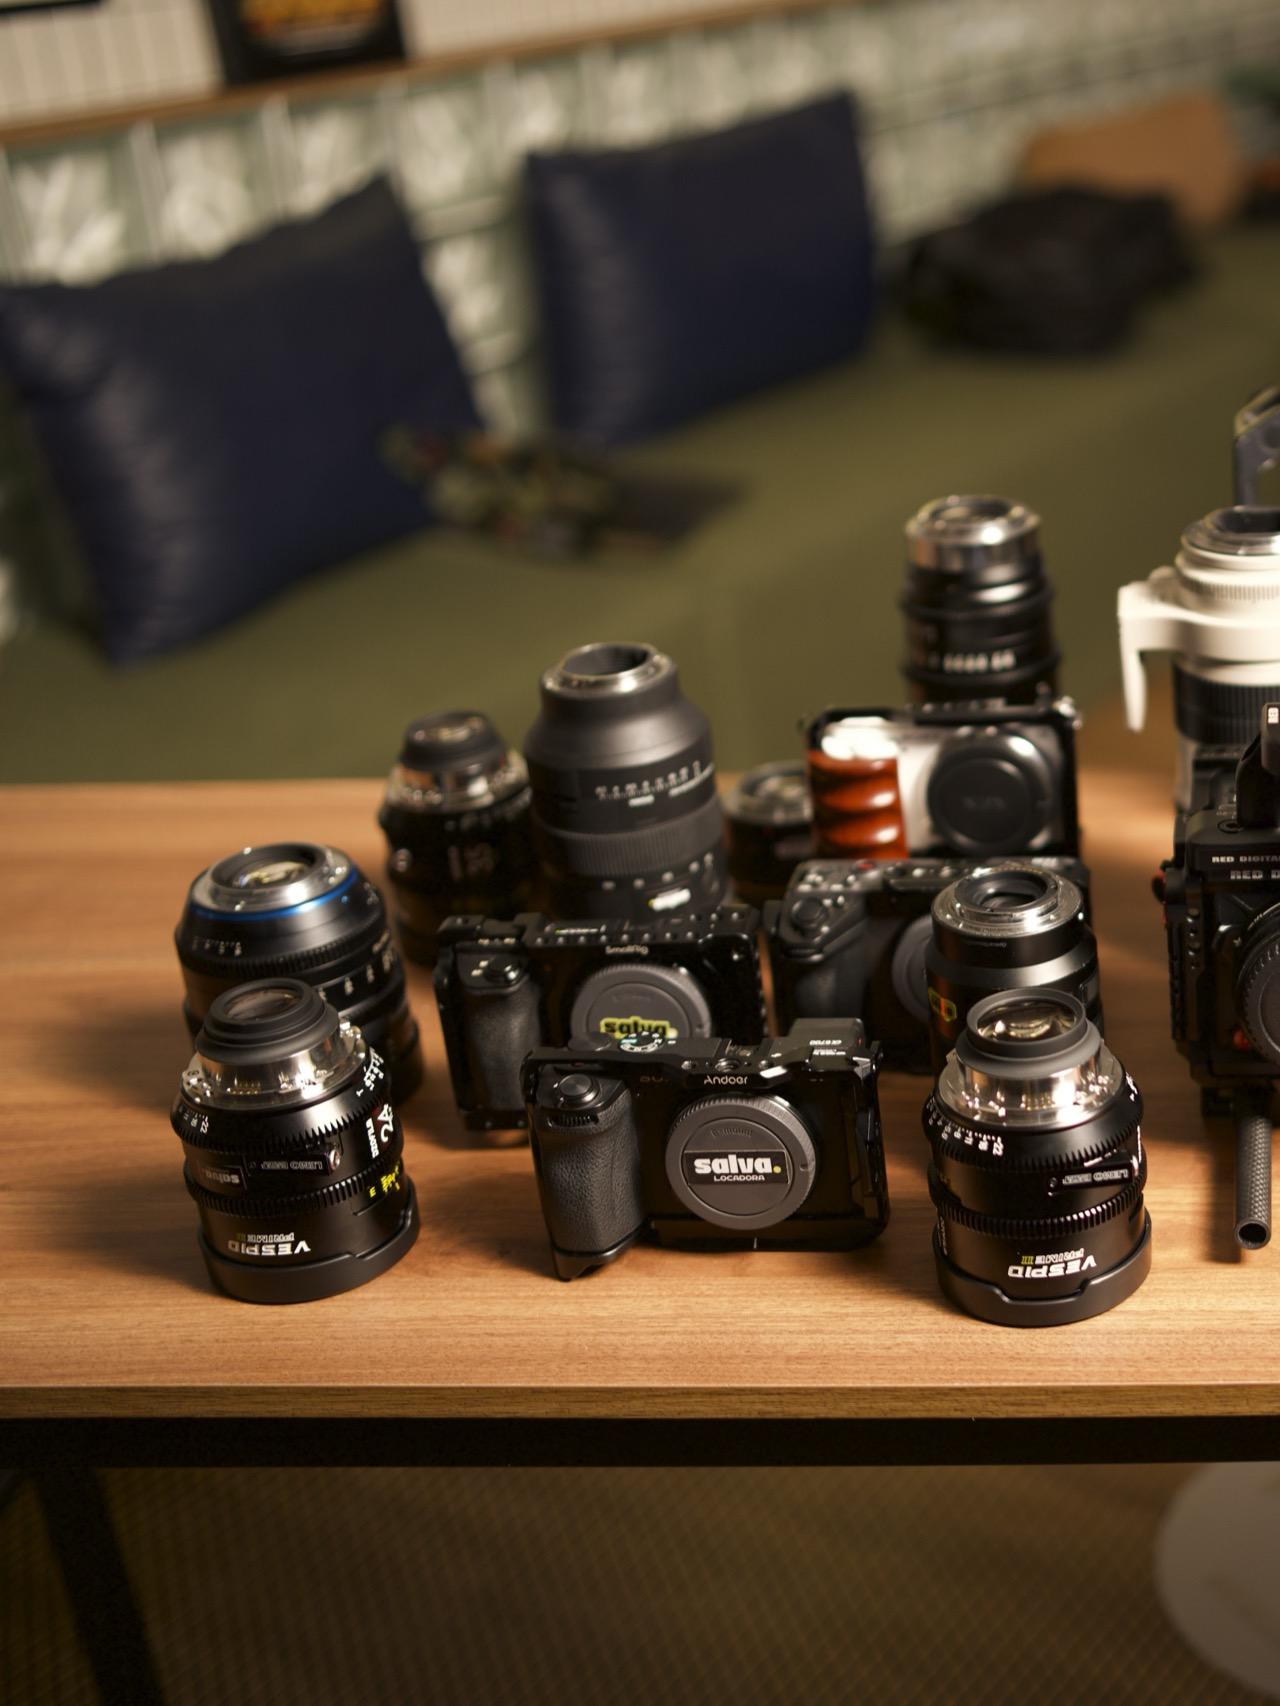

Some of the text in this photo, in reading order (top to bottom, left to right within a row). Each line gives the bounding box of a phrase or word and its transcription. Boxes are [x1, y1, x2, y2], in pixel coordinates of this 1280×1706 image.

[1230, 870, 1264, 880] RED
[704, 1075, 748, 1085] Andoer
[228, 1240, 311, 1256] VESPID
[1035, 1247, 1085, 1265] PRIME
[1007, 1255, 1097, 1278] VESPID
